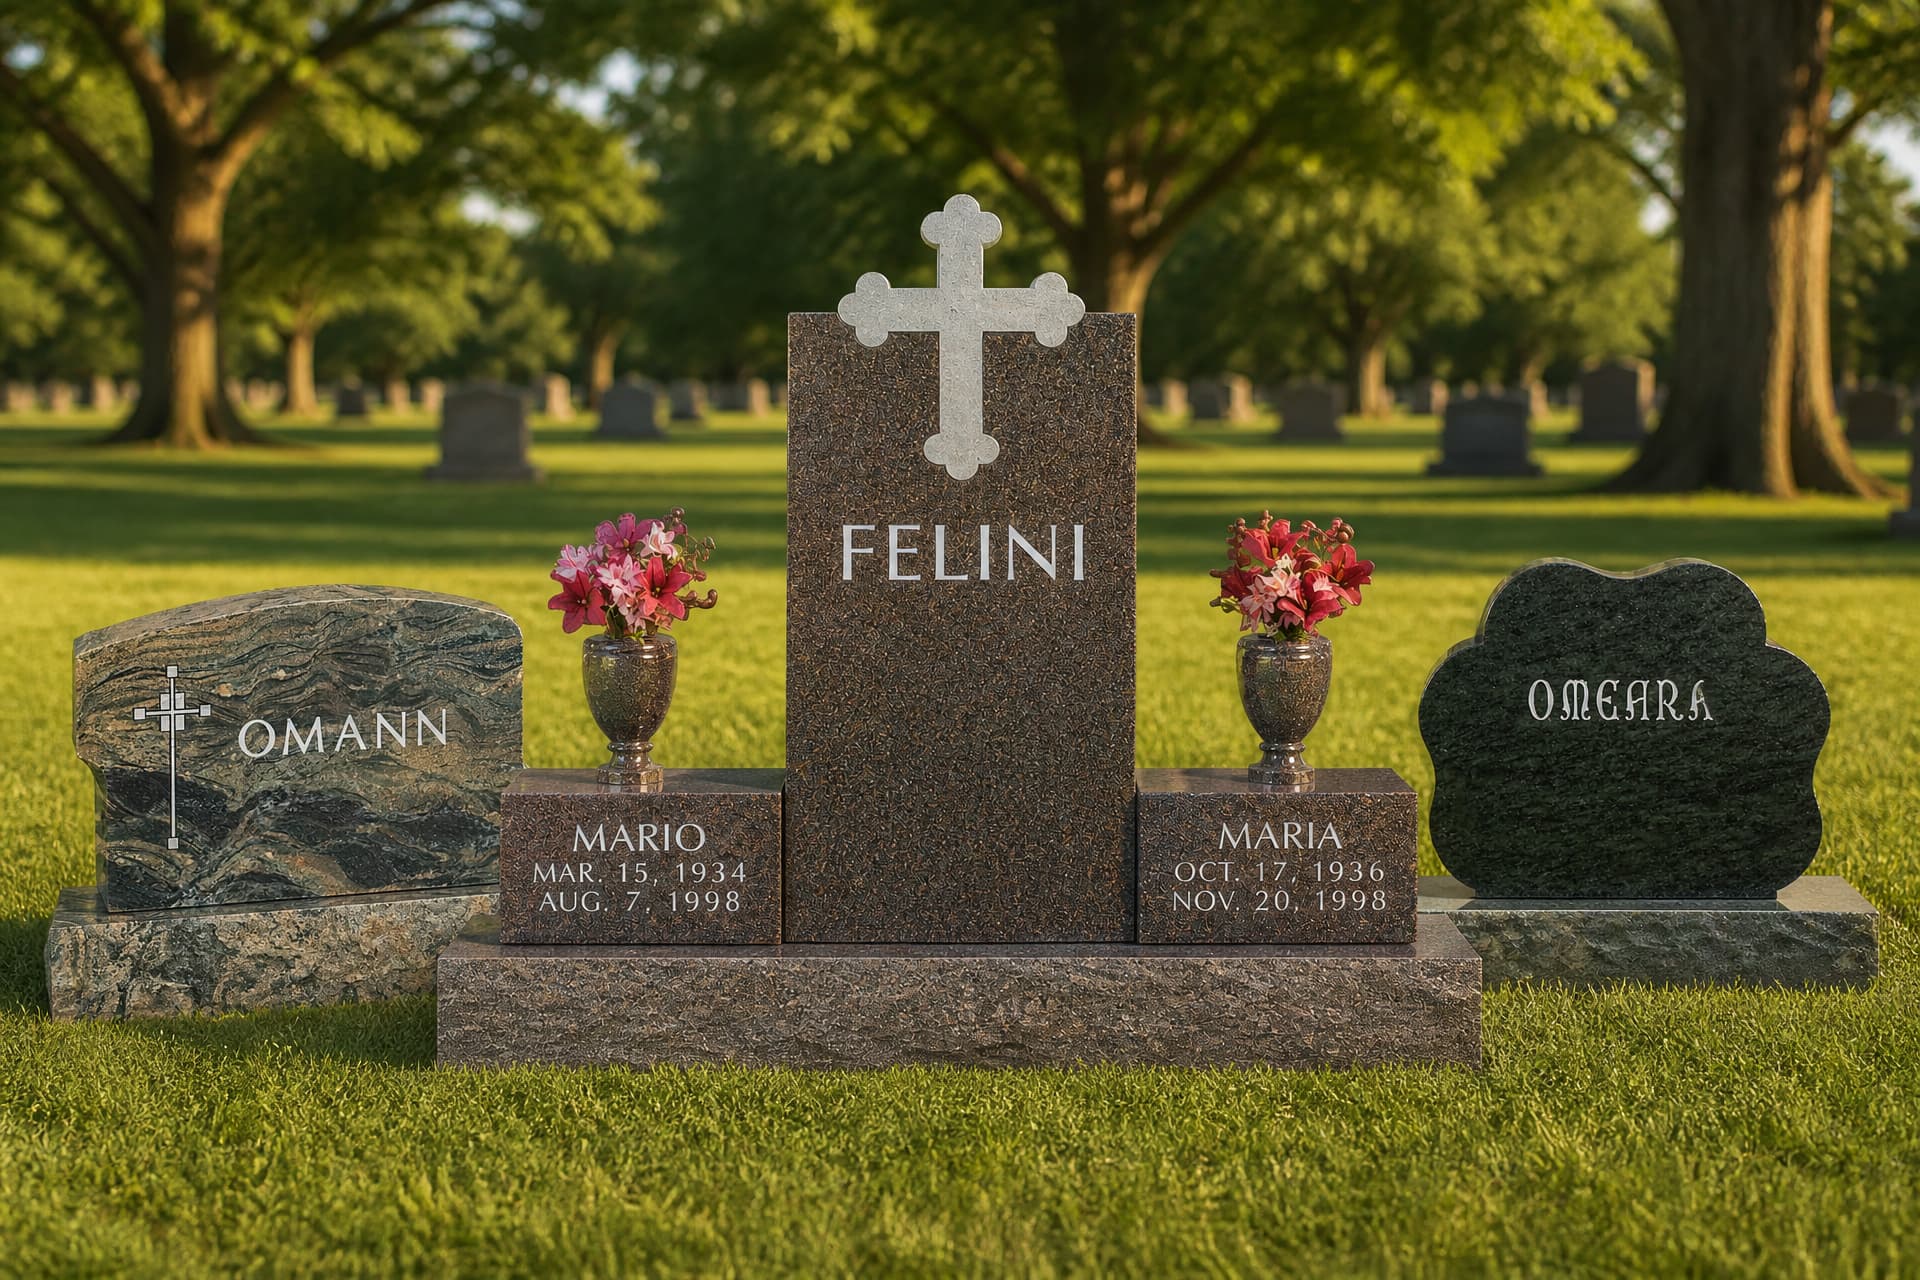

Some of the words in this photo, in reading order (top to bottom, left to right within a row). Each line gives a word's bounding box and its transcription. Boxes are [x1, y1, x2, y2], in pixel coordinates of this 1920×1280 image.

[842, 524, 1085, 582] FELINI
[1528, 679, 1714, 721] OMEARA
[238, 708, 447, 760] OMANN
[572, 823, 706, 852] MARIO
[1218, 821, 1343, 850] MARIA
[533, 862, 603, 883] MAR.
[618, 862, 658, 887] 15,
[676, 862, 746, 884] 1934
[1174, 861, 1240, 882] OCT.
[1255, 861, 1298, 885] 17,
[1313, 860, 1385, 882] 1936
[538, 891, 608, 912] AUG.
[669, 891, 741, 912] 1998
[1173, 890, 1240, 912] NOV.
[1255, 890, 1299, 914] 20,
[1316, 889, 1386, 912] 1998
